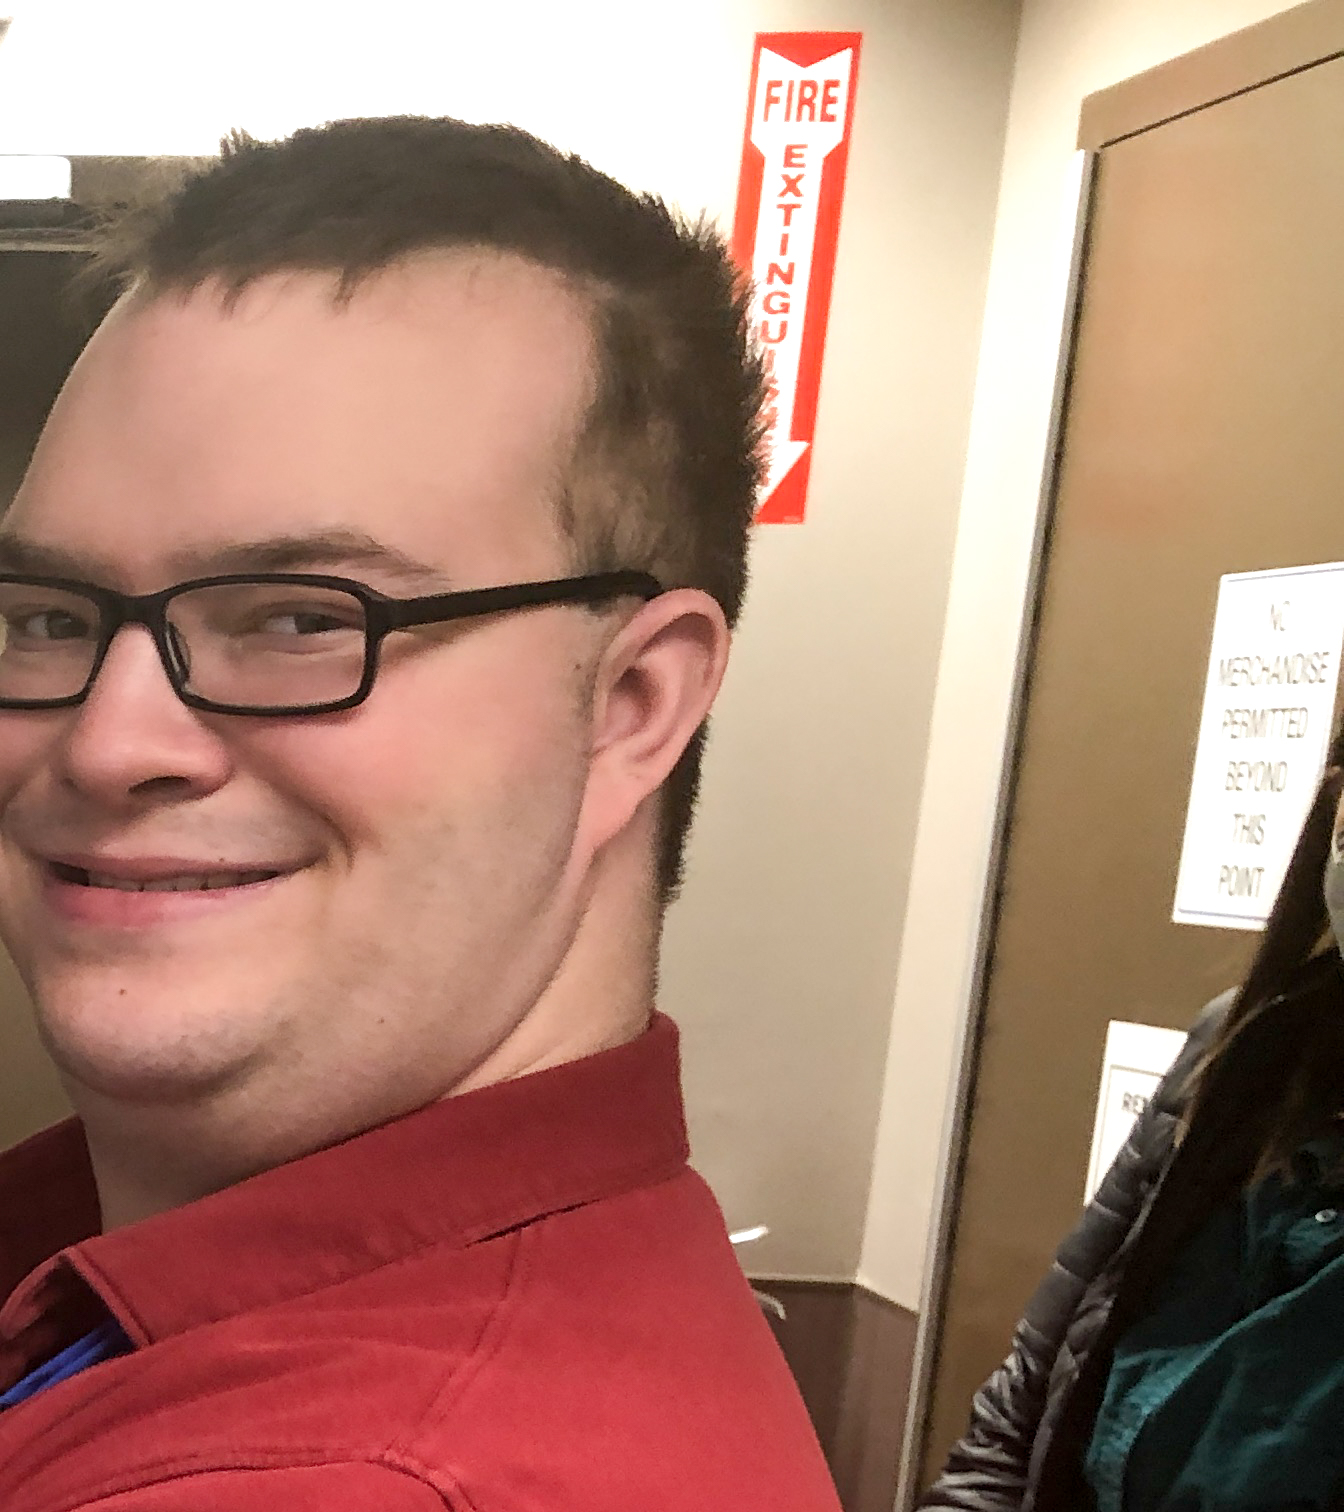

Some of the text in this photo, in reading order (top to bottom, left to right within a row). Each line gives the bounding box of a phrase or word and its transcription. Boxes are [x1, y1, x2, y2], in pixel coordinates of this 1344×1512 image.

[763, 80, 842, 123] FIRE
[1270, 601, 1290, 632] NO
[1219, 652, 1329, 686] MERCHANDISE
[1222, 707, 1308, 739] PERMITTED
[1226, 761, 1288, 792] BEYOND
[1233, 813, 1266, 845] THIS
[1218, 865, 1264, 897] POINT
